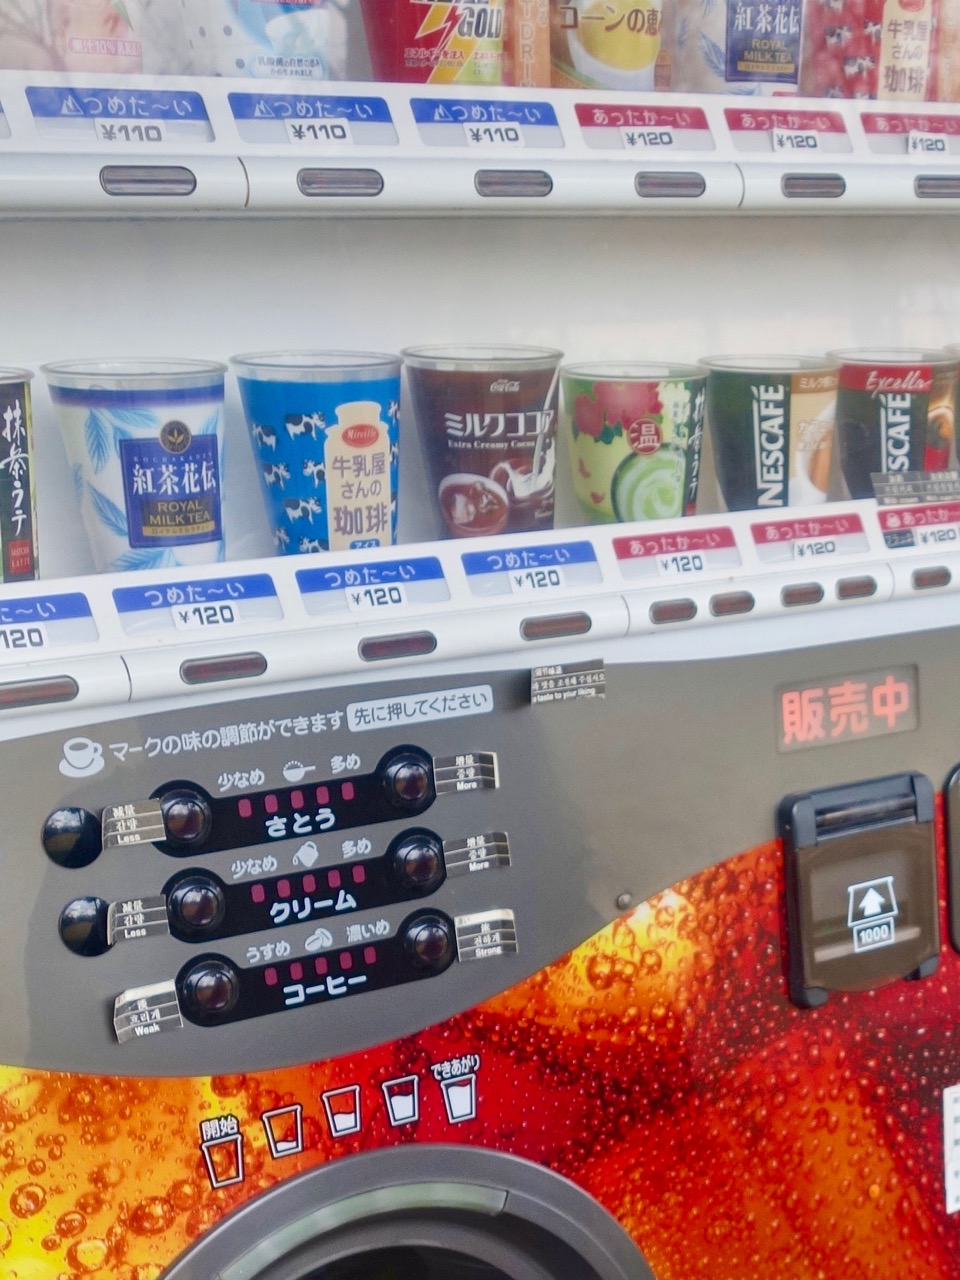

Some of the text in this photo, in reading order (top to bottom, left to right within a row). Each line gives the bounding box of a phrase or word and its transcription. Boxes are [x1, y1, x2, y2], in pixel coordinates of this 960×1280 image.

[752, 38, 787, 50] ROYAL
[892, 43, 923, 60] さんの
[744, 51, 792, 62] MILK TEA
[884, 65, 925, 93] 珈琲
[101, 124, 162, 142] ¥110
[291, 124, 347, 140] ¥110
[469, 127, 519, 142] ¥110
[627, 132, 674, 146] ¥120
[776, 134, 818, 149] ¥120
[911, 138, 946, 152] ¥120
[444, 409, 554, 437] ミルクココア
[751, 384, 785, 507] NESCAFÉ
[332, 452, 385, 478] 牛乳屋
[132, 461, 216, 495] 紅茶花伝
[341, 480, 382, 499] さんの
[157, 501, 203, 512] ROYAL
[150, 511, 210, 525] MILK TEA
[333, 503, 388, 535] 珈琲
[920, 529, 957, 544] ¥120
[797, 540, 836, 558] ¥120
[661, 555, 703, 573] ¥120
[514, 569, 561, 590] ¥120
[351, 586, 402, 607] ¥120
[178, 604, 235, 626] ¥120
[353, 691, 488, 727] 先に押してください
[782, 675, 910, 745] 販売中
[109, 710, 343, 762] マークの味の調節ができます
[330, 754, 361, 774] 多め
[217, 769, 265, 792] 少なめ
[456, 780, 477, 791] More
[265, 807, 336, 838] さとう
[117, 834, 141, 845] Less
[341, 838, 372, 859] 多め
[230, 855, 278, 879] 少なめ
[468, 860, 490, 872] More
[270, 889, 357, 924] クリーム
[124, 928, 147, 939] Less
[346, 918, 390, 943] 濃いめ
[858, 923, 889, 942] 1000
[246, 940, 291, 963] うすめ
[475, 946, 502, 959] Strong
[283, 974, 367, 1006] コーヒー
[135, 1022, 160, 1037] Weak
[431, 1054, 480, 1080] できあがり
[201, 1115, 240, 1140] 開始
